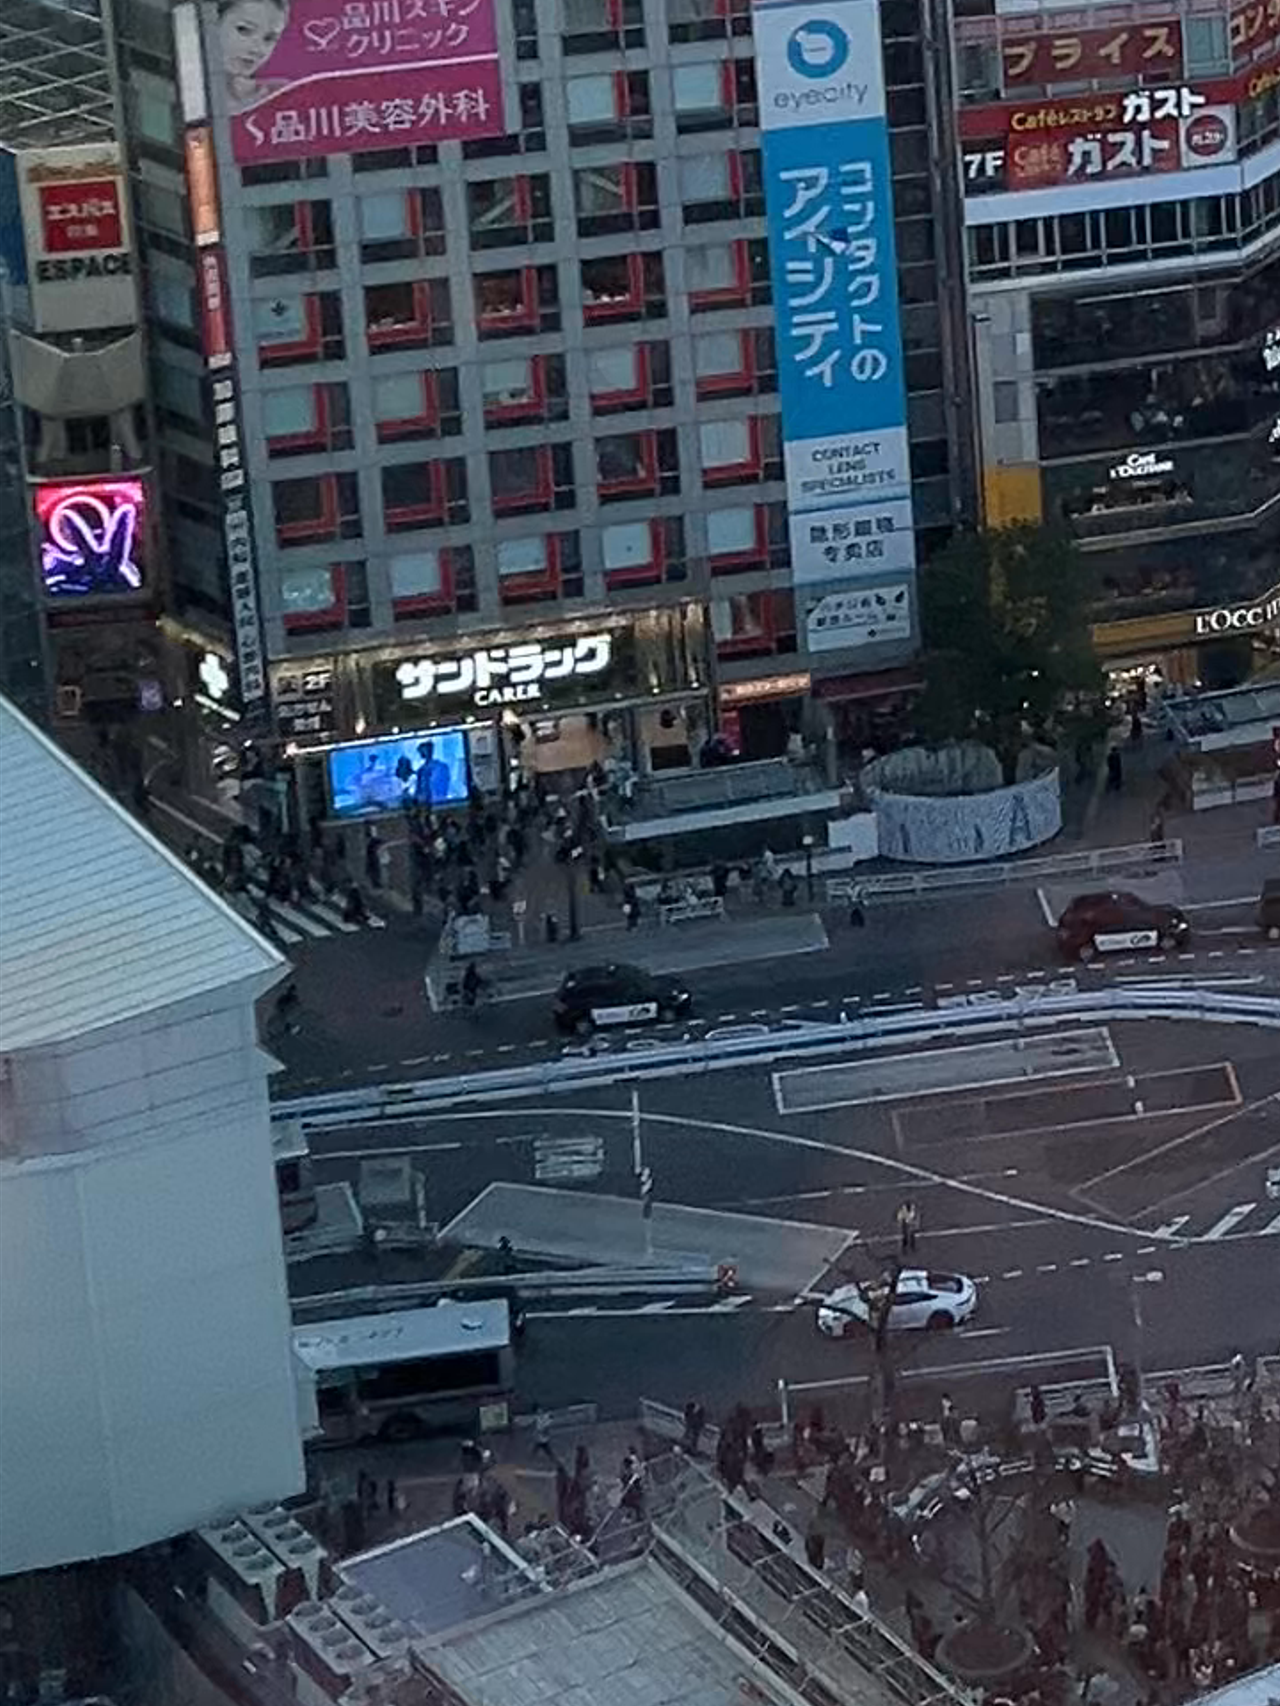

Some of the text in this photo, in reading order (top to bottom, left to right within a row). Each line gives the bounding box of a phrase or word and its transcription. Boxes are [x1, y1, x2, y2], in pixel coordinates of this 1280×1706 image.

[345, 22, 471, 60] クリニック
[1003, 28, 1178, 78] プライス
[270, 87, 493, 146] 品川美容外科
[773, 81, 869, 111] eyecity
[1121, 86, 1207, 125] ガスト
[963, 149, 1006, 179] 7F
[1066, 128, 1171, 178] ガスト
[778, 165, 842, 388] アイシティ
[837, 159, 889, 383] コンタクトの
[811, 441, 882, 463] CONTACT
[394, 632, 612, 701] サンドラッグ
